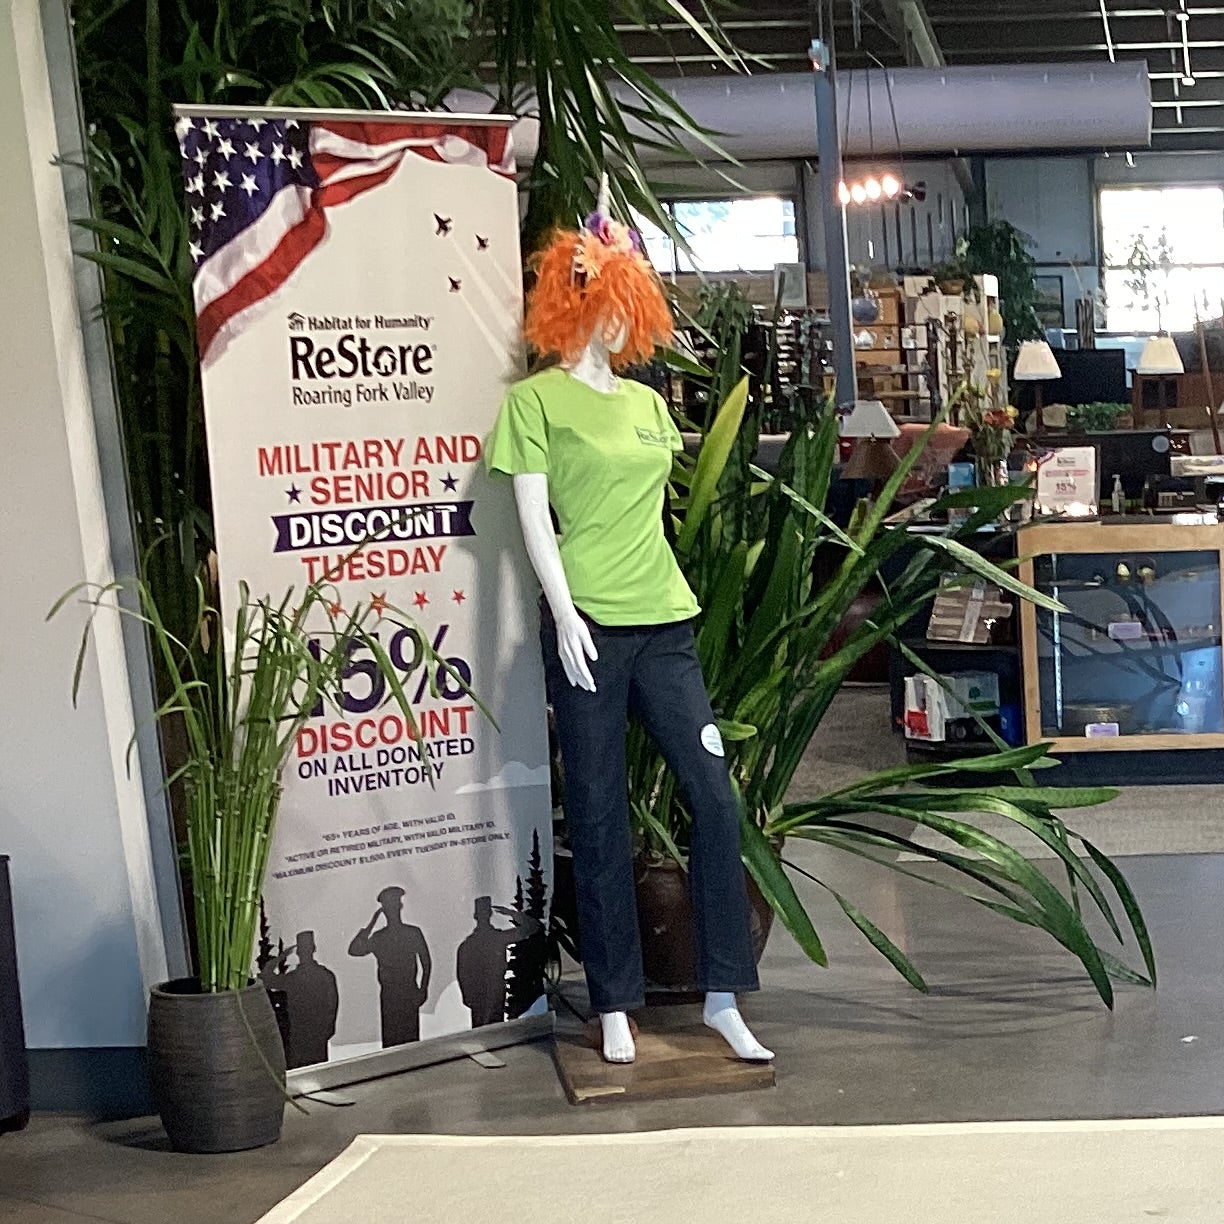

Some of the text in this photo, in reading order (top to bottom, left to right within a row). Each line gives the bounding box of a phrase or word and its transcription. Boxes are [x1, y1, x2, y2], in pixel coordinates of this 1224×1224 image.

[307, 314, 432, 331] Habitat for Humanity
[289, 335, 434, 380] ReStore
[292, 381, 434, 407] Roaring Fork Valley
[257, 434, 482, 477] MILITARY AND
[309, 470, 431, 506] SENIOR
[289, 504, 458, 548] DISCOUNT
[301, 545, 447, 585] TUESDAY
[295, 705, 474, 758] DISCOUNT
[298, 738, 475, 780] ON ALL DONATED
[328, 762, 444, 797] INVENTORY
[342, 827, 370, 839] YEARS
[371, 825, 381, 835] OF
[387, 847, 413, 859] EVERY
